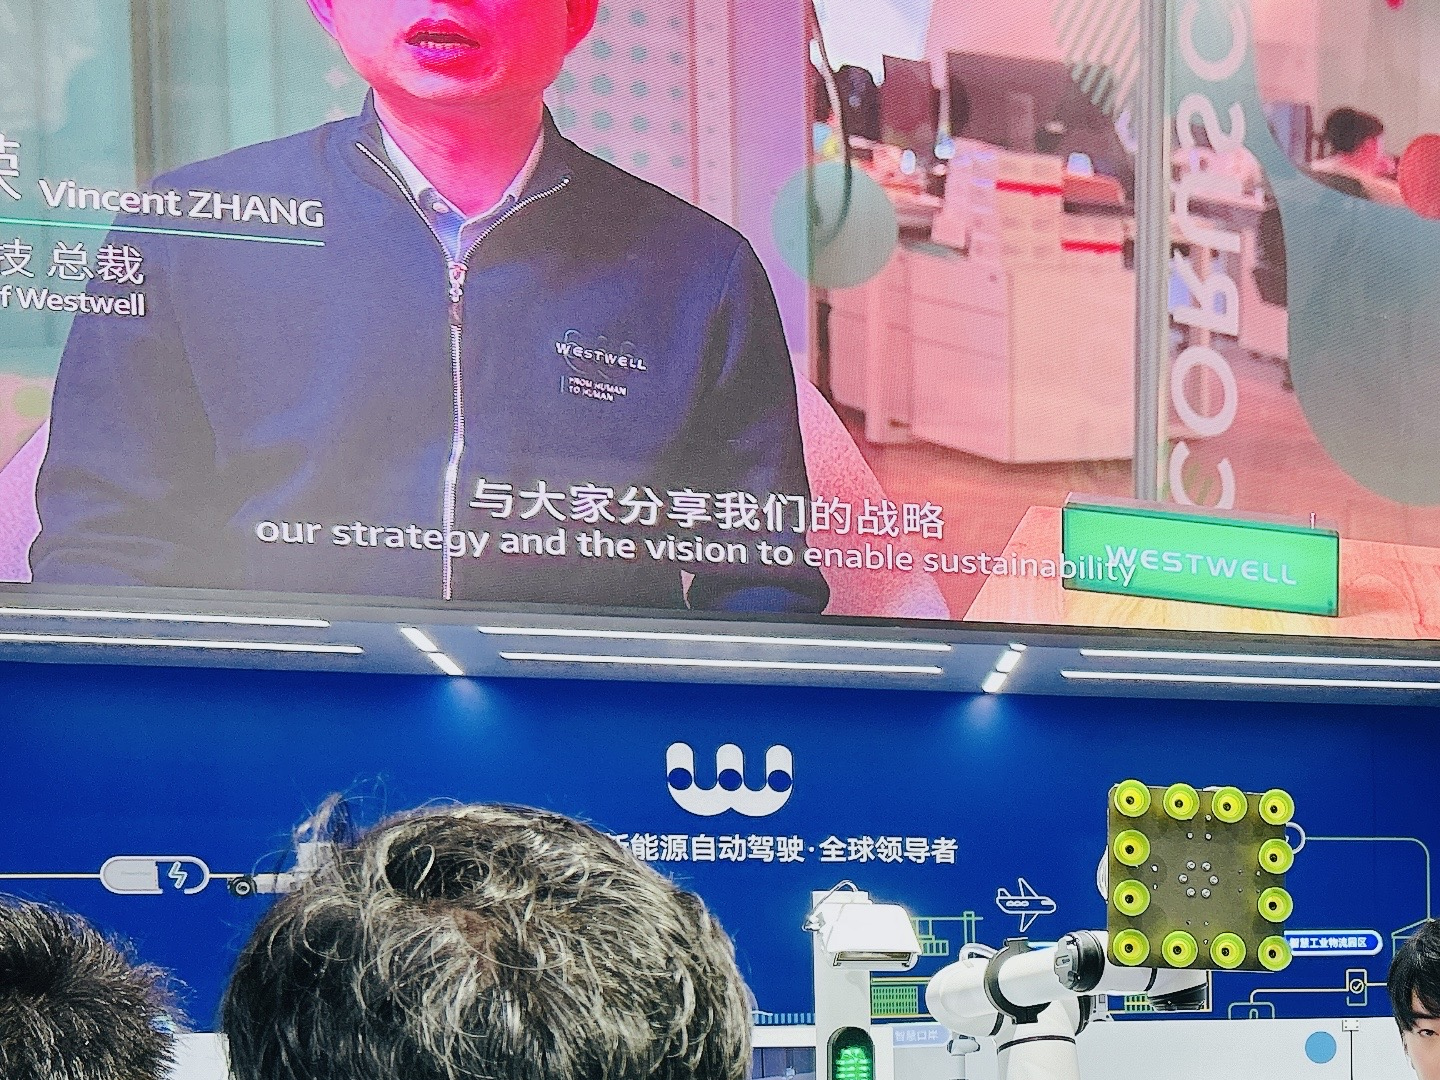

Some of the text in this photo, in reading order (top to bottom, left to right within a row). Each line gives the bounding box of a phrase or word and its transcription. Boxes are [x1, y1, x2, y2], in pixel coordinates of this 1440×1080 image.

[37, 178, 325, 229] Vincent ZHANG
[46, 240, 146, 286] 总裁
[0, 284, 147, 317] f Westwell
[554, 341, 648, 372] WESTWELL
[469, 477, 945, 541] 与大家分享我们的战略
[255, 520, 1137, 587] our strategy and the vision to enable sustainability
[1104, 544, 1297, 585] WESTWELL
